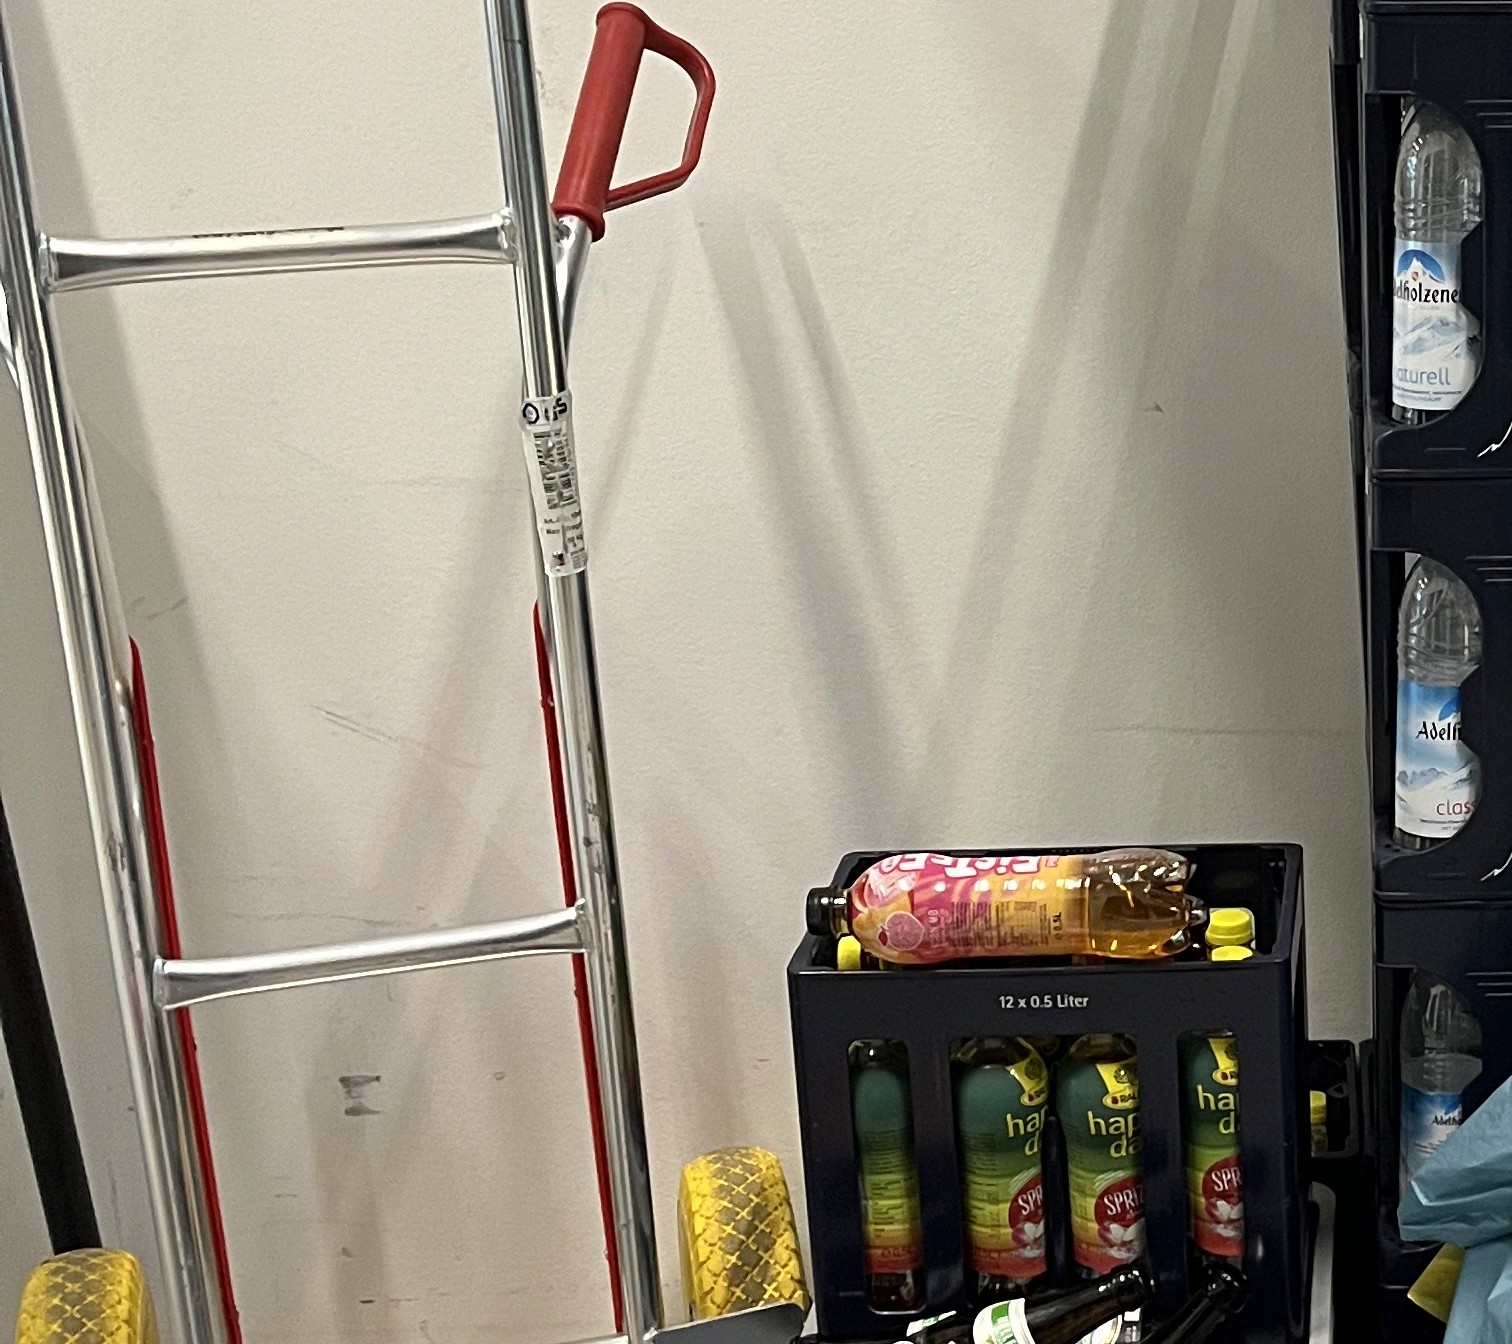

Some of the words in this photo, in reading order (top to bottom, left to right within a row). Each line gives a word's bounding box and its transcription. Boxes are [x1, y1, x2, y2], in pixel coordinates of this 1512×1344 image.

[999, 995, 1014, 1010] 12
[1017, 999, 1027, 1010] x
[1030, 995, 1053, 1010] 0.5
[1057, 993, 1090, 1010] Liter
